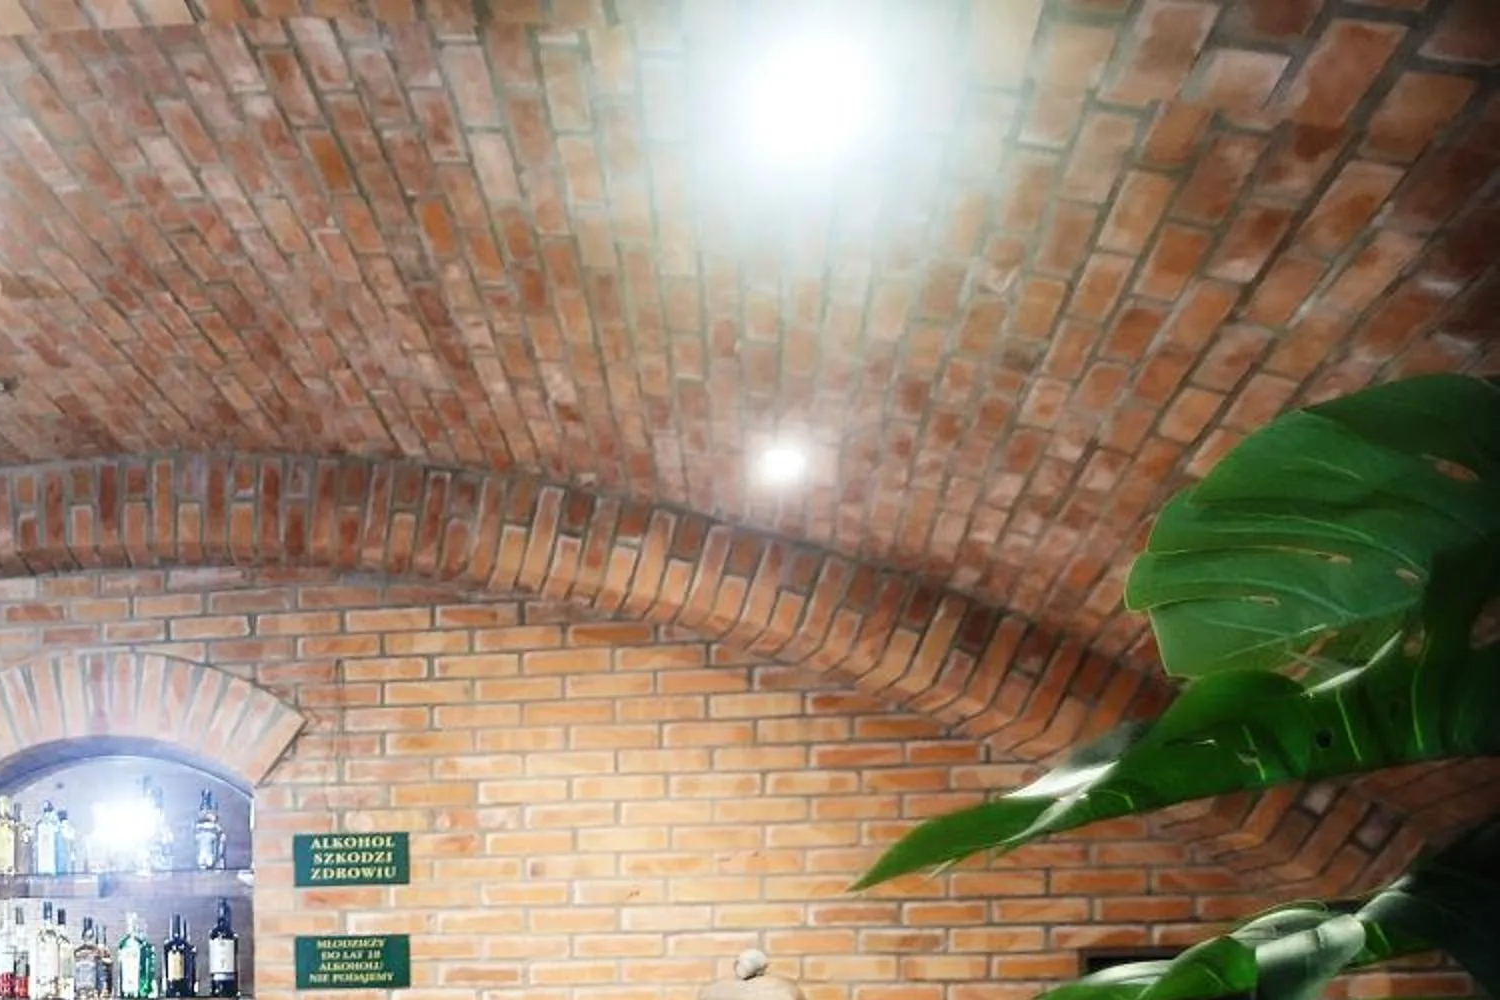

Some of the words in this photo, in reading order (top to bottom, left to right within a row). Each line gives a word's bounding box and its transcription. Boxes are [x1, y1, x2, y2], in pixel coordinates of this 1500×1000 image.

[310, 836, 395, 849] ALKOHOL
[313, 851, 393, 864] SZKODZI
[310, 866, 397, 880] ZDROWIU
